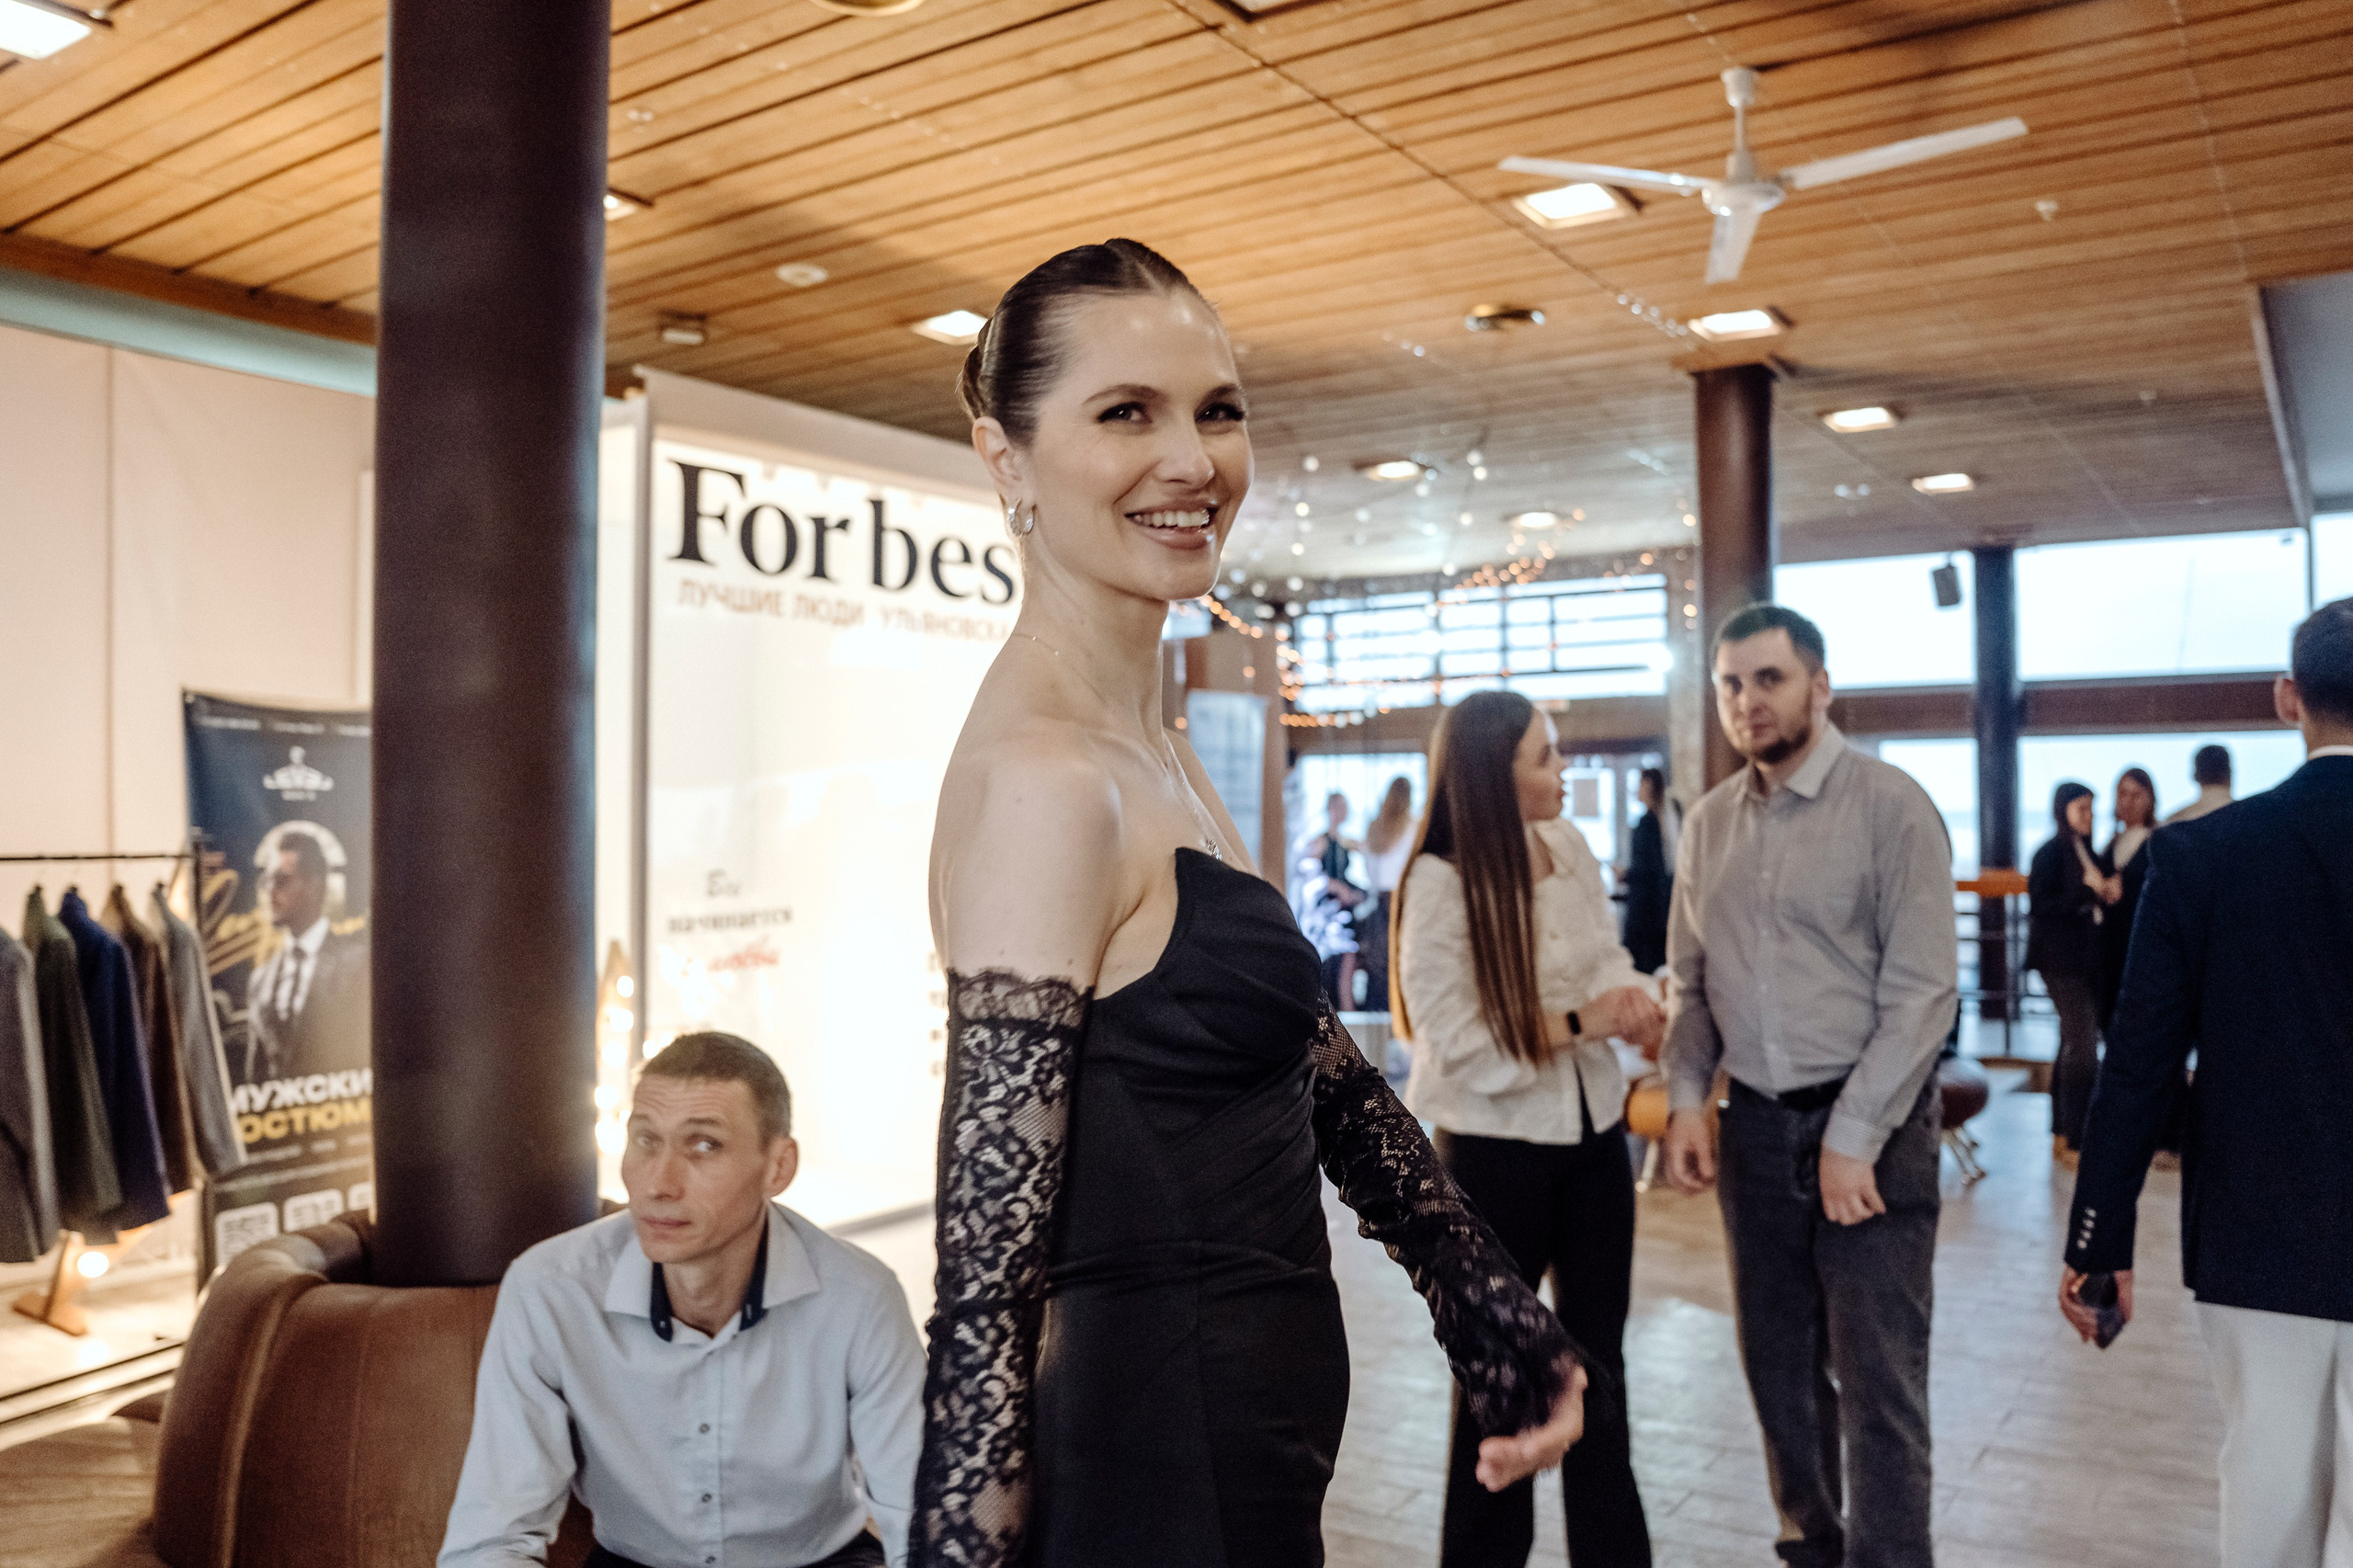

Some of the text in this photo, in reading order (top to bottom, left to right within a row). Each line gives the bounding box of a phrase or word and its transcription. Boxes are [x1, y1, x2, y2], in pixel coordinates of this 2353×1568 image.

[668, 460, 1019, 605] Forbes
[677, 579, 1009, 642] ЛУЧШИЕ ЛЮДИ УЛЬЯНОВСК
